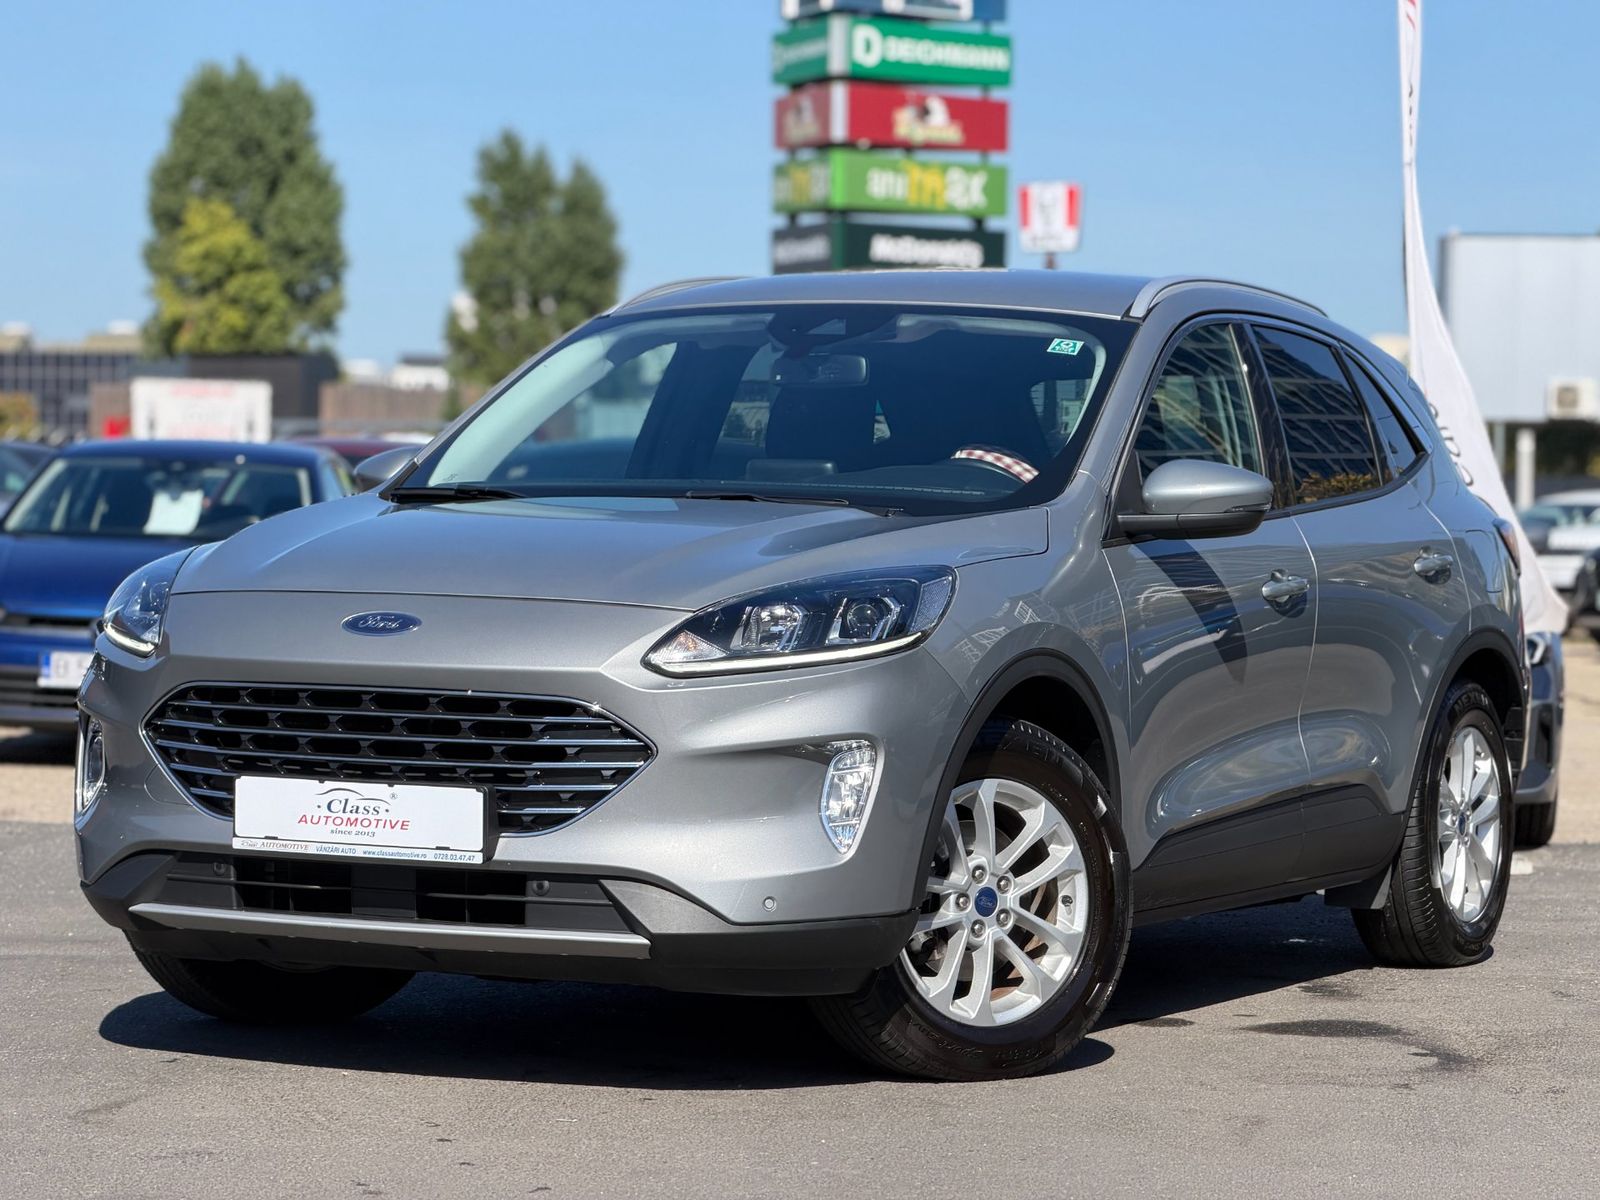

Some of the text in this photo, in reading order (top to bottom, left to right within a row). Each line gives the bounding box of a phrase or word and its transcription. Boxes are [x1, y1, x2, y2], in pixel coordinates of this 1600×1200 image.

[358, 616, 403, 629] Ford
[326, 798, 381, 816] Class
[298, 814, 411, 831] AUTOMOTIVE
[330, 828, 376, 838] since 2013
[260, 841, 310, 852] AUTOMOTIVE
[340, 847, 357, 855] AUTO
[362, 848, 428, 860] www.classautomotive.ro
[433, 852, 476, 863] 0728.03.47.47
